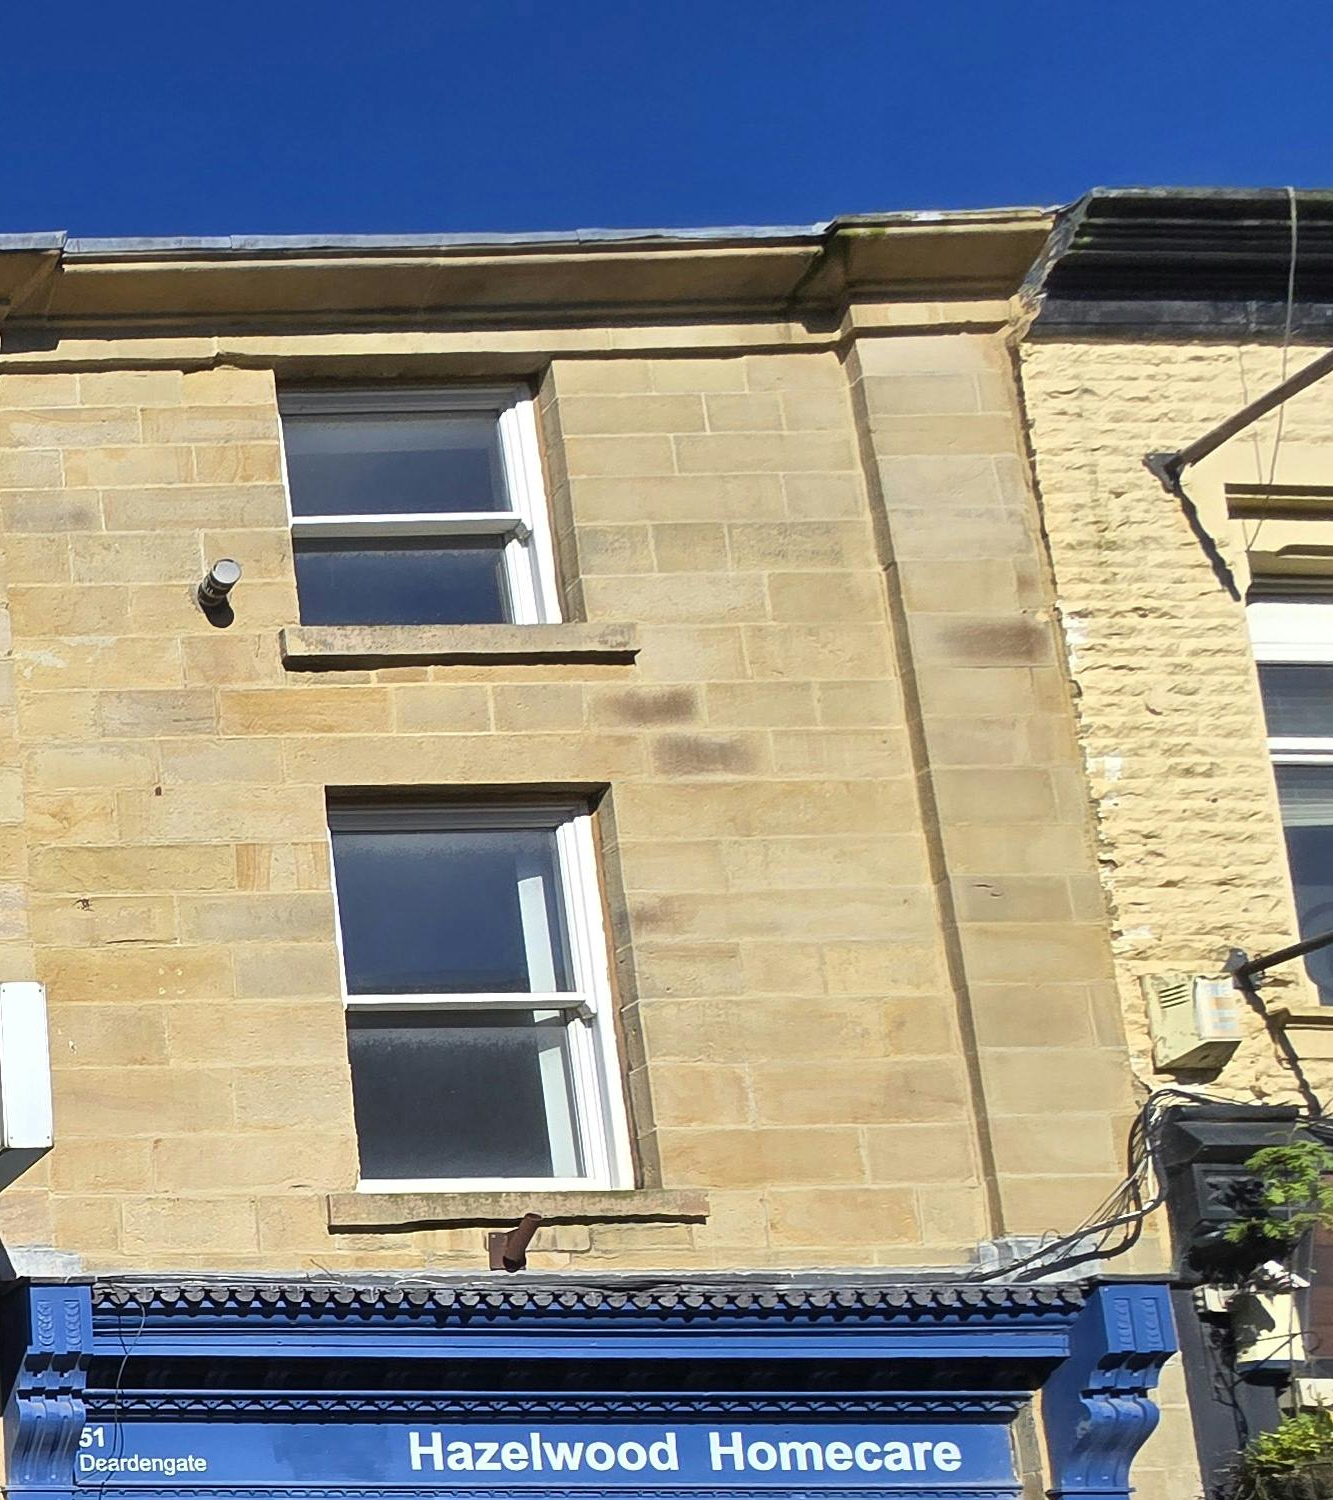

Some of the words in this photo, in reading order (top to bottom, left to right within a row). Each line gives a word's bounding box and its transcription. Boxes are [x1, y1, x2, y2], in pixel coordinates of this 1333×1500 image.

[78, 1426, 105, 1448] 51
[408, 1431, 679, 1472] Hazelwood
[708, 1431, 963, 1472] Homecare
[78, 1453, 207, 1476] Deardengate
